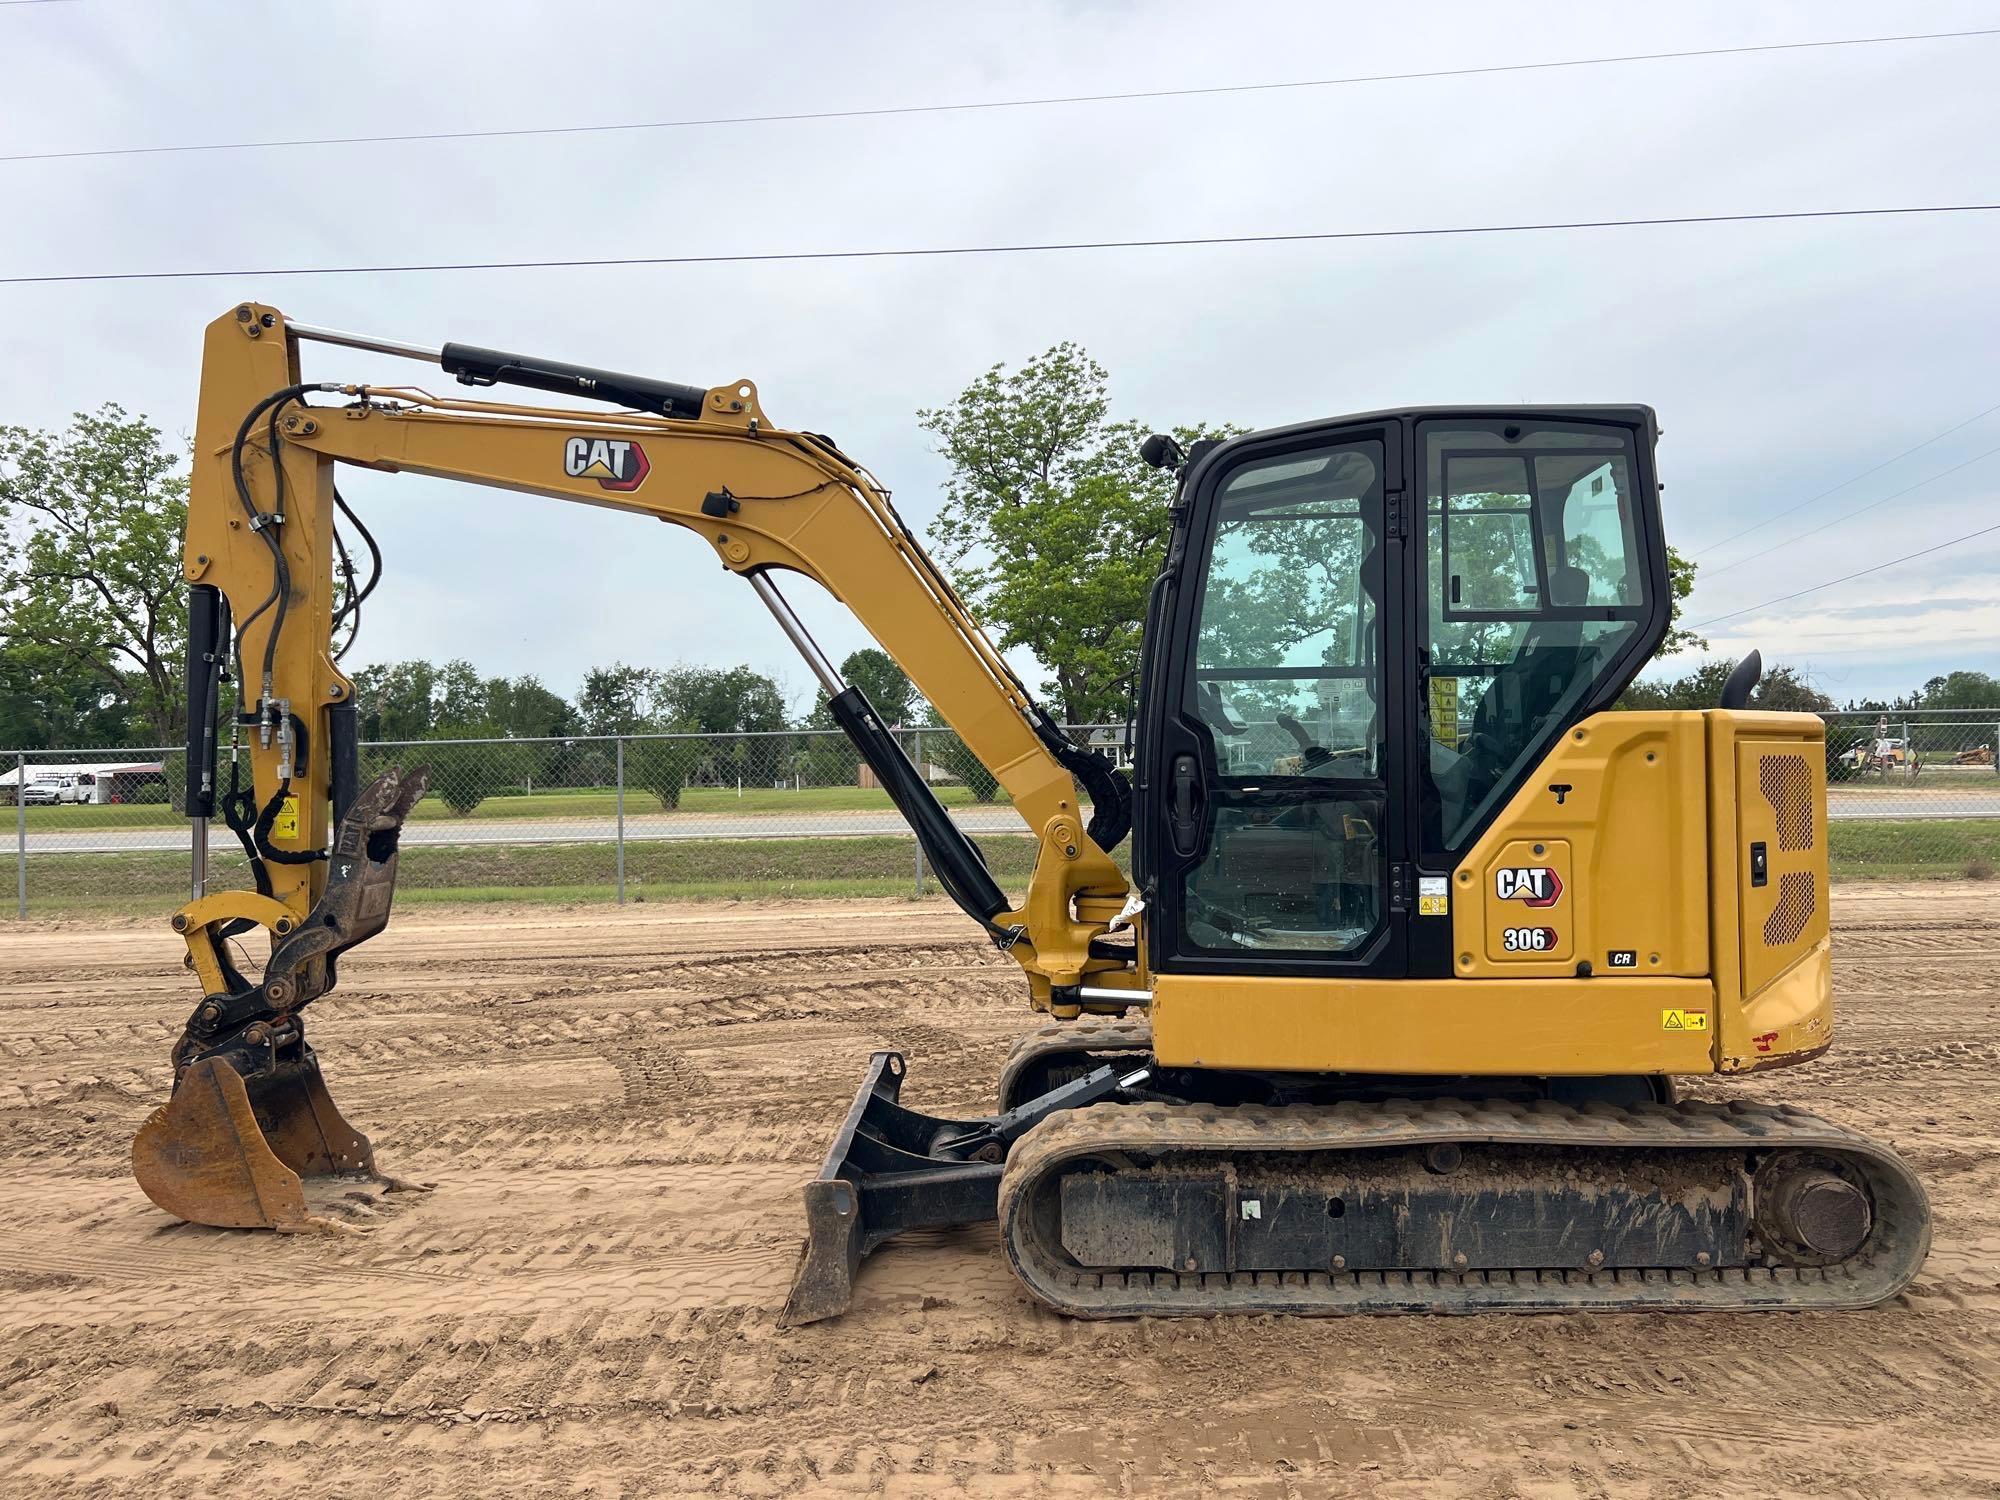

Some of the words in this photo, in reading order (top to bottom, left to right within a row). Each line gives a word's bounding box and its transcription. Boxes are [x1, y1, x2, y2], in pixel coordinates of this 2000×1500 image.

[565, 438, 631, 480] CAT
[1497, 868, 1546, 899] CAT
[1503, 928, 1545, 951] 306
[1614, 953, 1631, 965] CR
